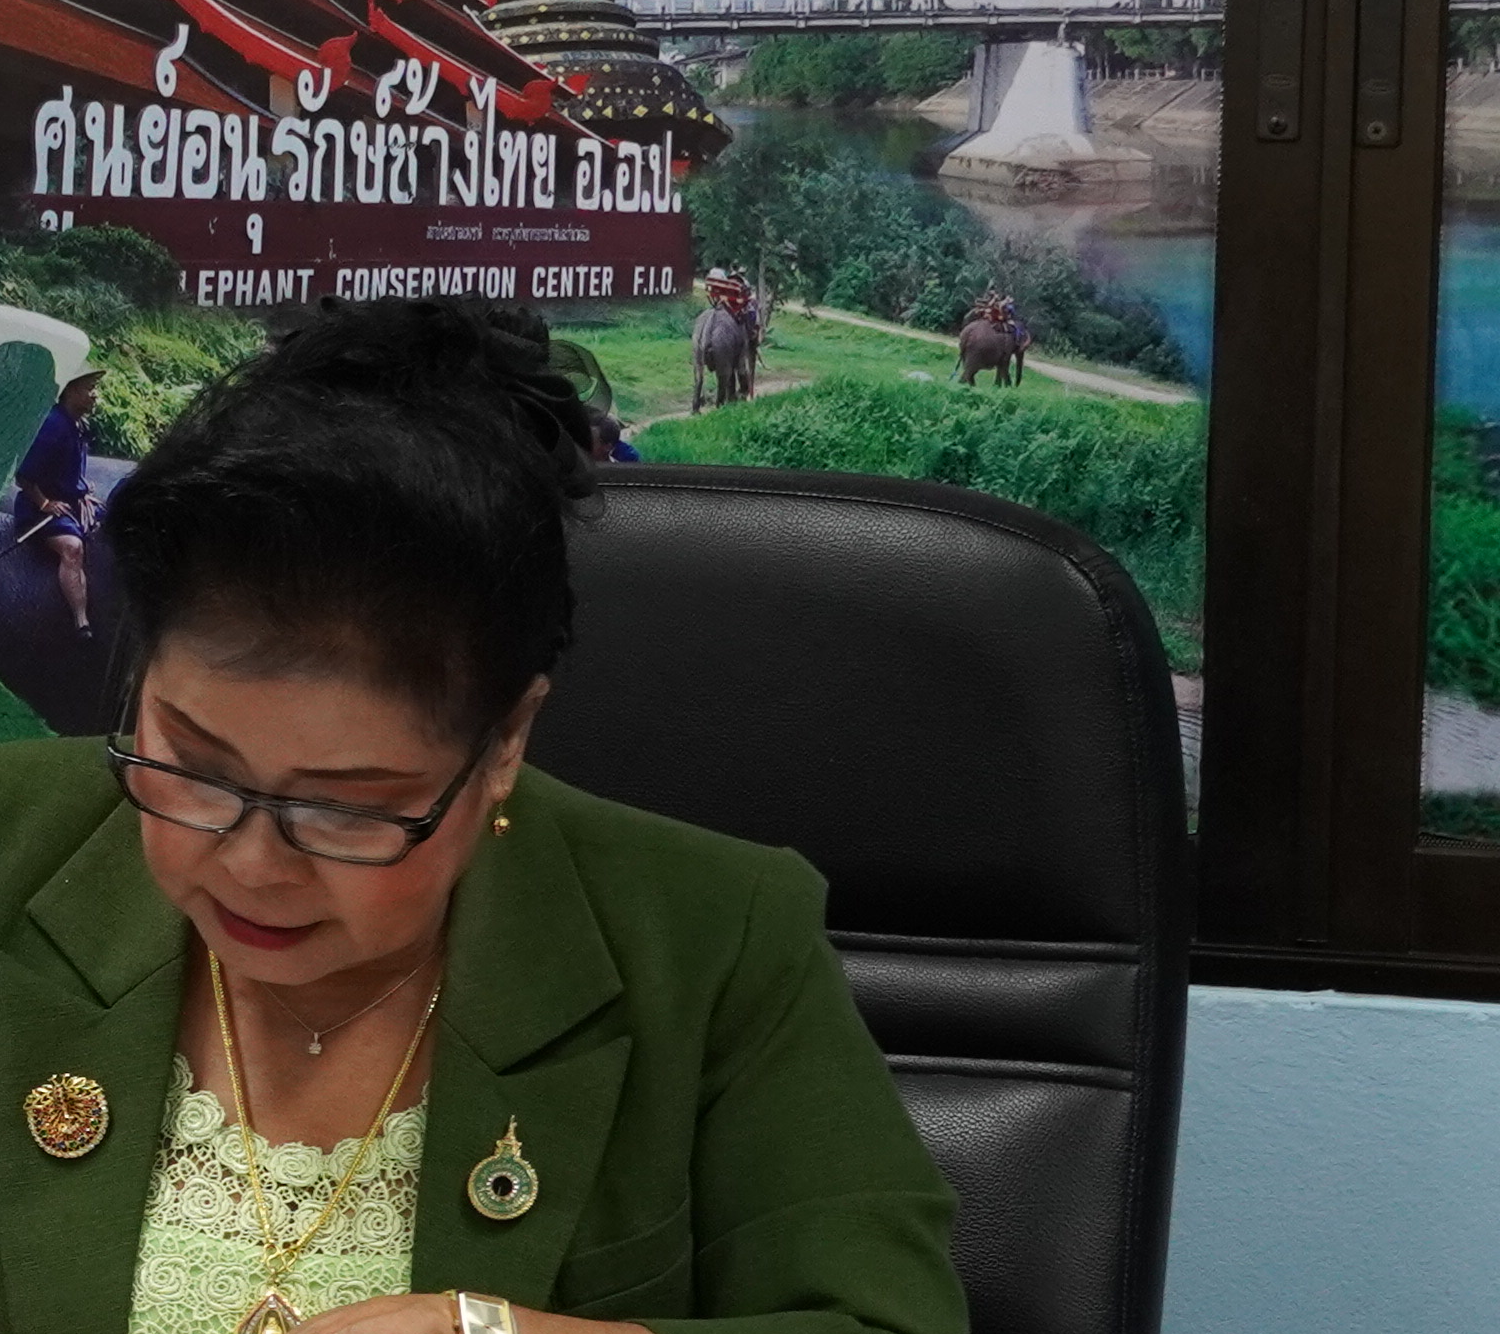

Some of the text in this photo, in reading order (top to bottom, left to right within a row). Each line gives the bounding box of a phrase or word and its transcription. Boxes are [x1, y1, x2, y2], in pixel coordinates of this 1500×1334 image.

[576, 130, 682, 214] อ.อ.ป.
[336, 266, 517, 302] CONSERVATION
[531, 267, 614, 299] CENTER
[633, 266, 677, 297] F.I.O.
